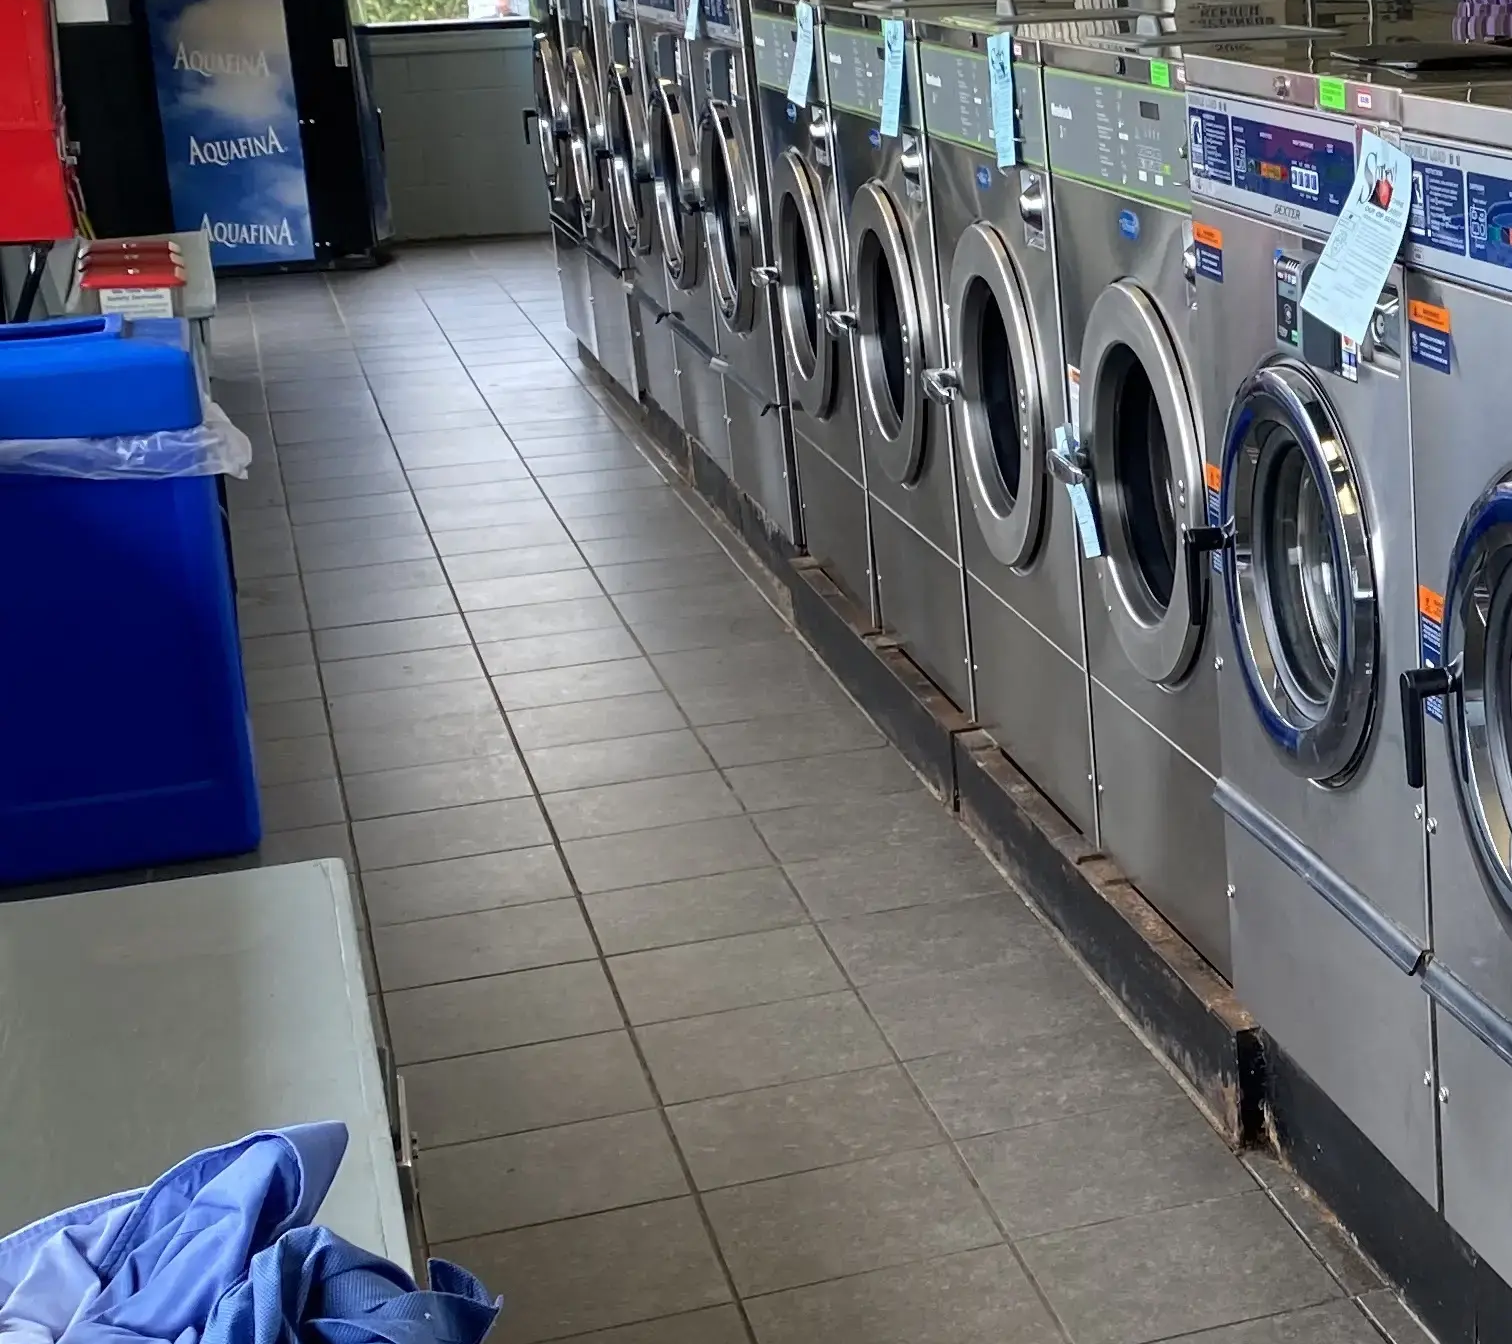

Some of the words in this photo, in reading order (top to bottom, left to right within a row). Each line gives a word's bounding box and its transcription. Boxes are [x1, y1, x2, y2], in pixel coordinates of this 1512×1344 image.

[173, 41, 270, 77] AQUAFINA
[189, 124, 286, 167] AQUAFINA
[1274, 203, 1301, 220] DEXTER
[201, 212, 296, 248] AQUAFINA
